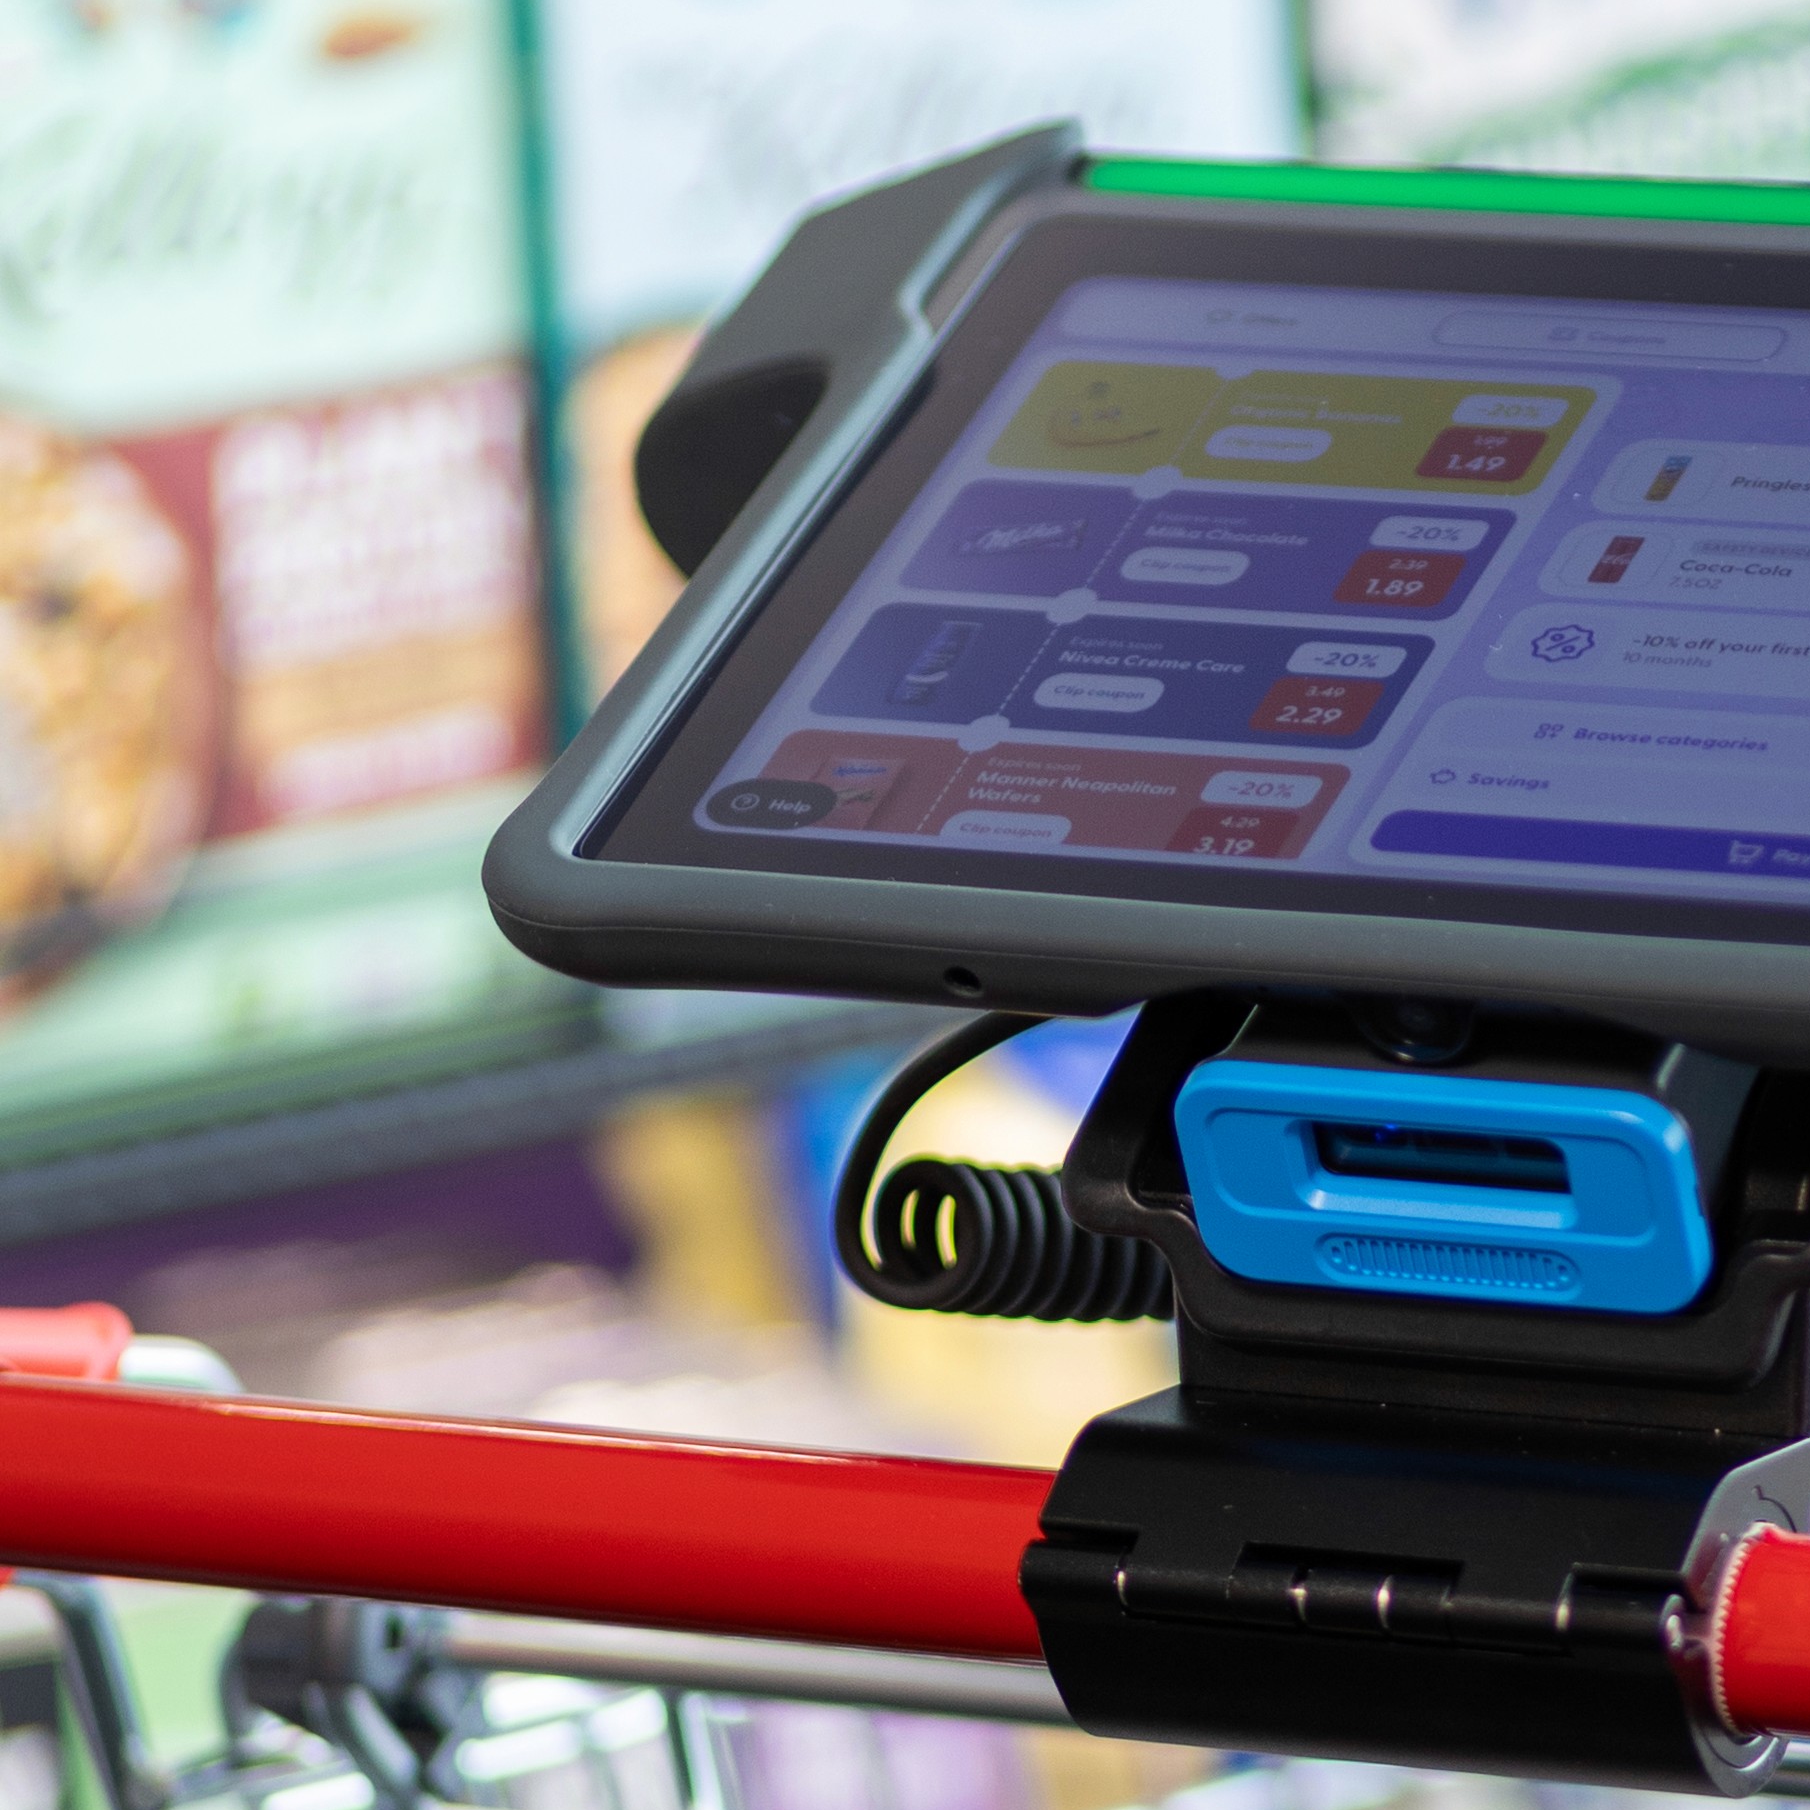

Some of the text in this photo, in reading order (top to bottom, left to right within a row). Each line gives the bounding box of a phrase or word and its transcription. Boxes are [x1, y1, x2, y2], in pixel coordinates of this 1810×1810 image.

[1478, 403, 1540, 420] -20%
[1445, 454, 1506, 473] 1.49
[1145, 526, 1310, 546] Milka Chocolate
[1396, 525, 1462, 542] -20%
[1140, 557, 1233, 575] Clip coupon
[1388, 558, 1429, 571] 2.39
[1679, 558, 1794, 579] Coca-Cola
[1365, 578, 1424, 596] 1.89
[1070, 636, 1164, 651] Expires soon
[1633, 633, 1680, 649] -10%
[1684, 636, 1716, 650] off
[1719, 642, 1768, 656] your
[1059, 650, 1247, 674] Nivea Creme Care
[1314, 652, 1377, 668] -20%
[1622, 651, 1713, 669] 10 months
[1054, 684, 1145, 701] Clip coupon
[1305, 685, 1346, 699] 3.49
[1275, 705, 1342, 724] 2.29
[1574, 727, 1769, 751] Browse categories
[988, 757, 1081, 772] Expires soon
[977, 770, 1177, 797] Manner Neapolitan
[1227, 781, 1294, 799] -20%
[1467, 772, 1551, 791] Savings
[967, 786, 1041, 803] Wafers
[768, 798, 812, 815] Help
[959, 822, 1052, 840] Clip coupon
[1220, 816, 1260, 828] 4.29
[1193, 836, 1255, 855] 3.19
